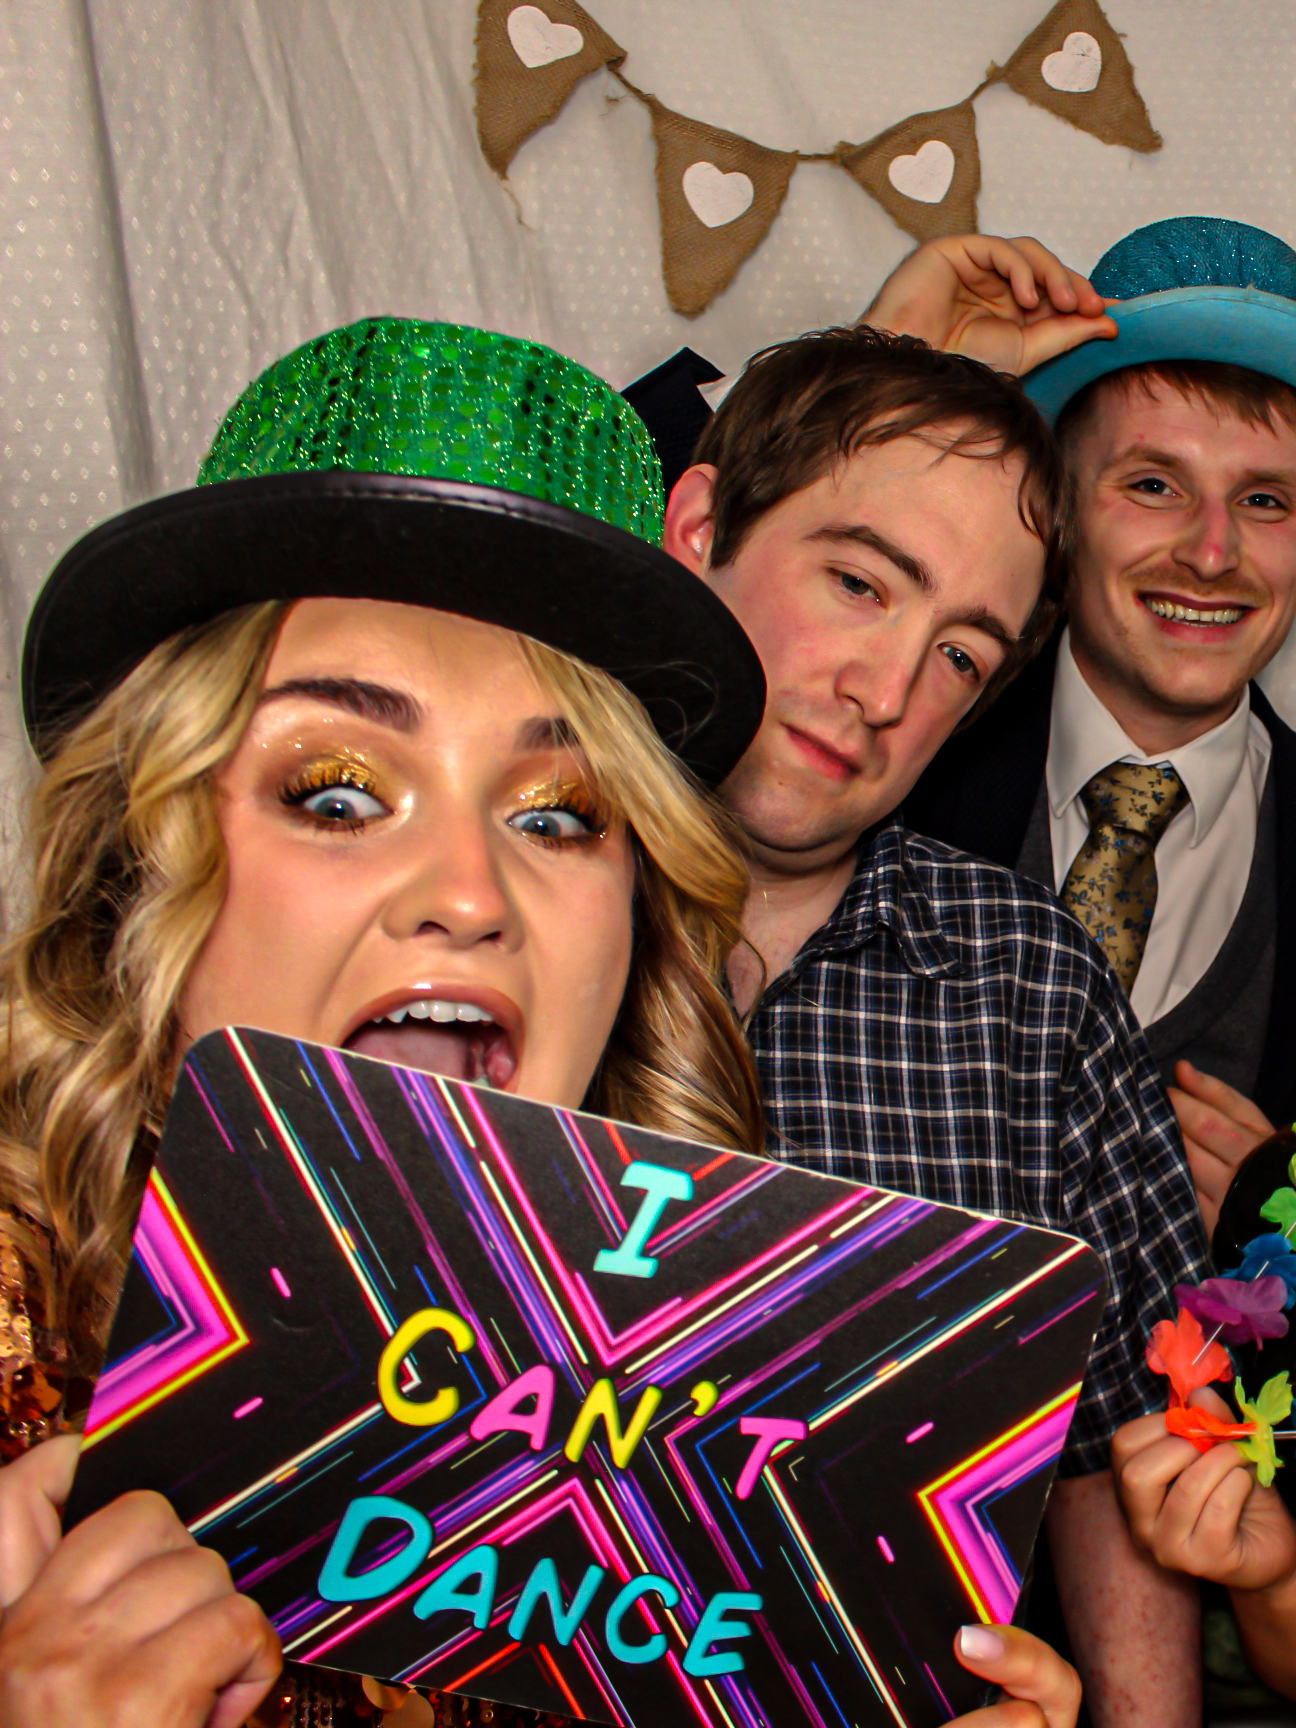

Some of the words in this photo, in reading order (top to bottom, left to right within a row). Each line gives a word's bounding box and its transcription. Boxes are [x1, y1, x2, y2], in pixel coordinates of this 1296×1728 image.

[593, 1161, 694, 1277] I
[377, 1308, 808, 1500] CAN'T
[318, 1495, 763, 1678] DANCE
